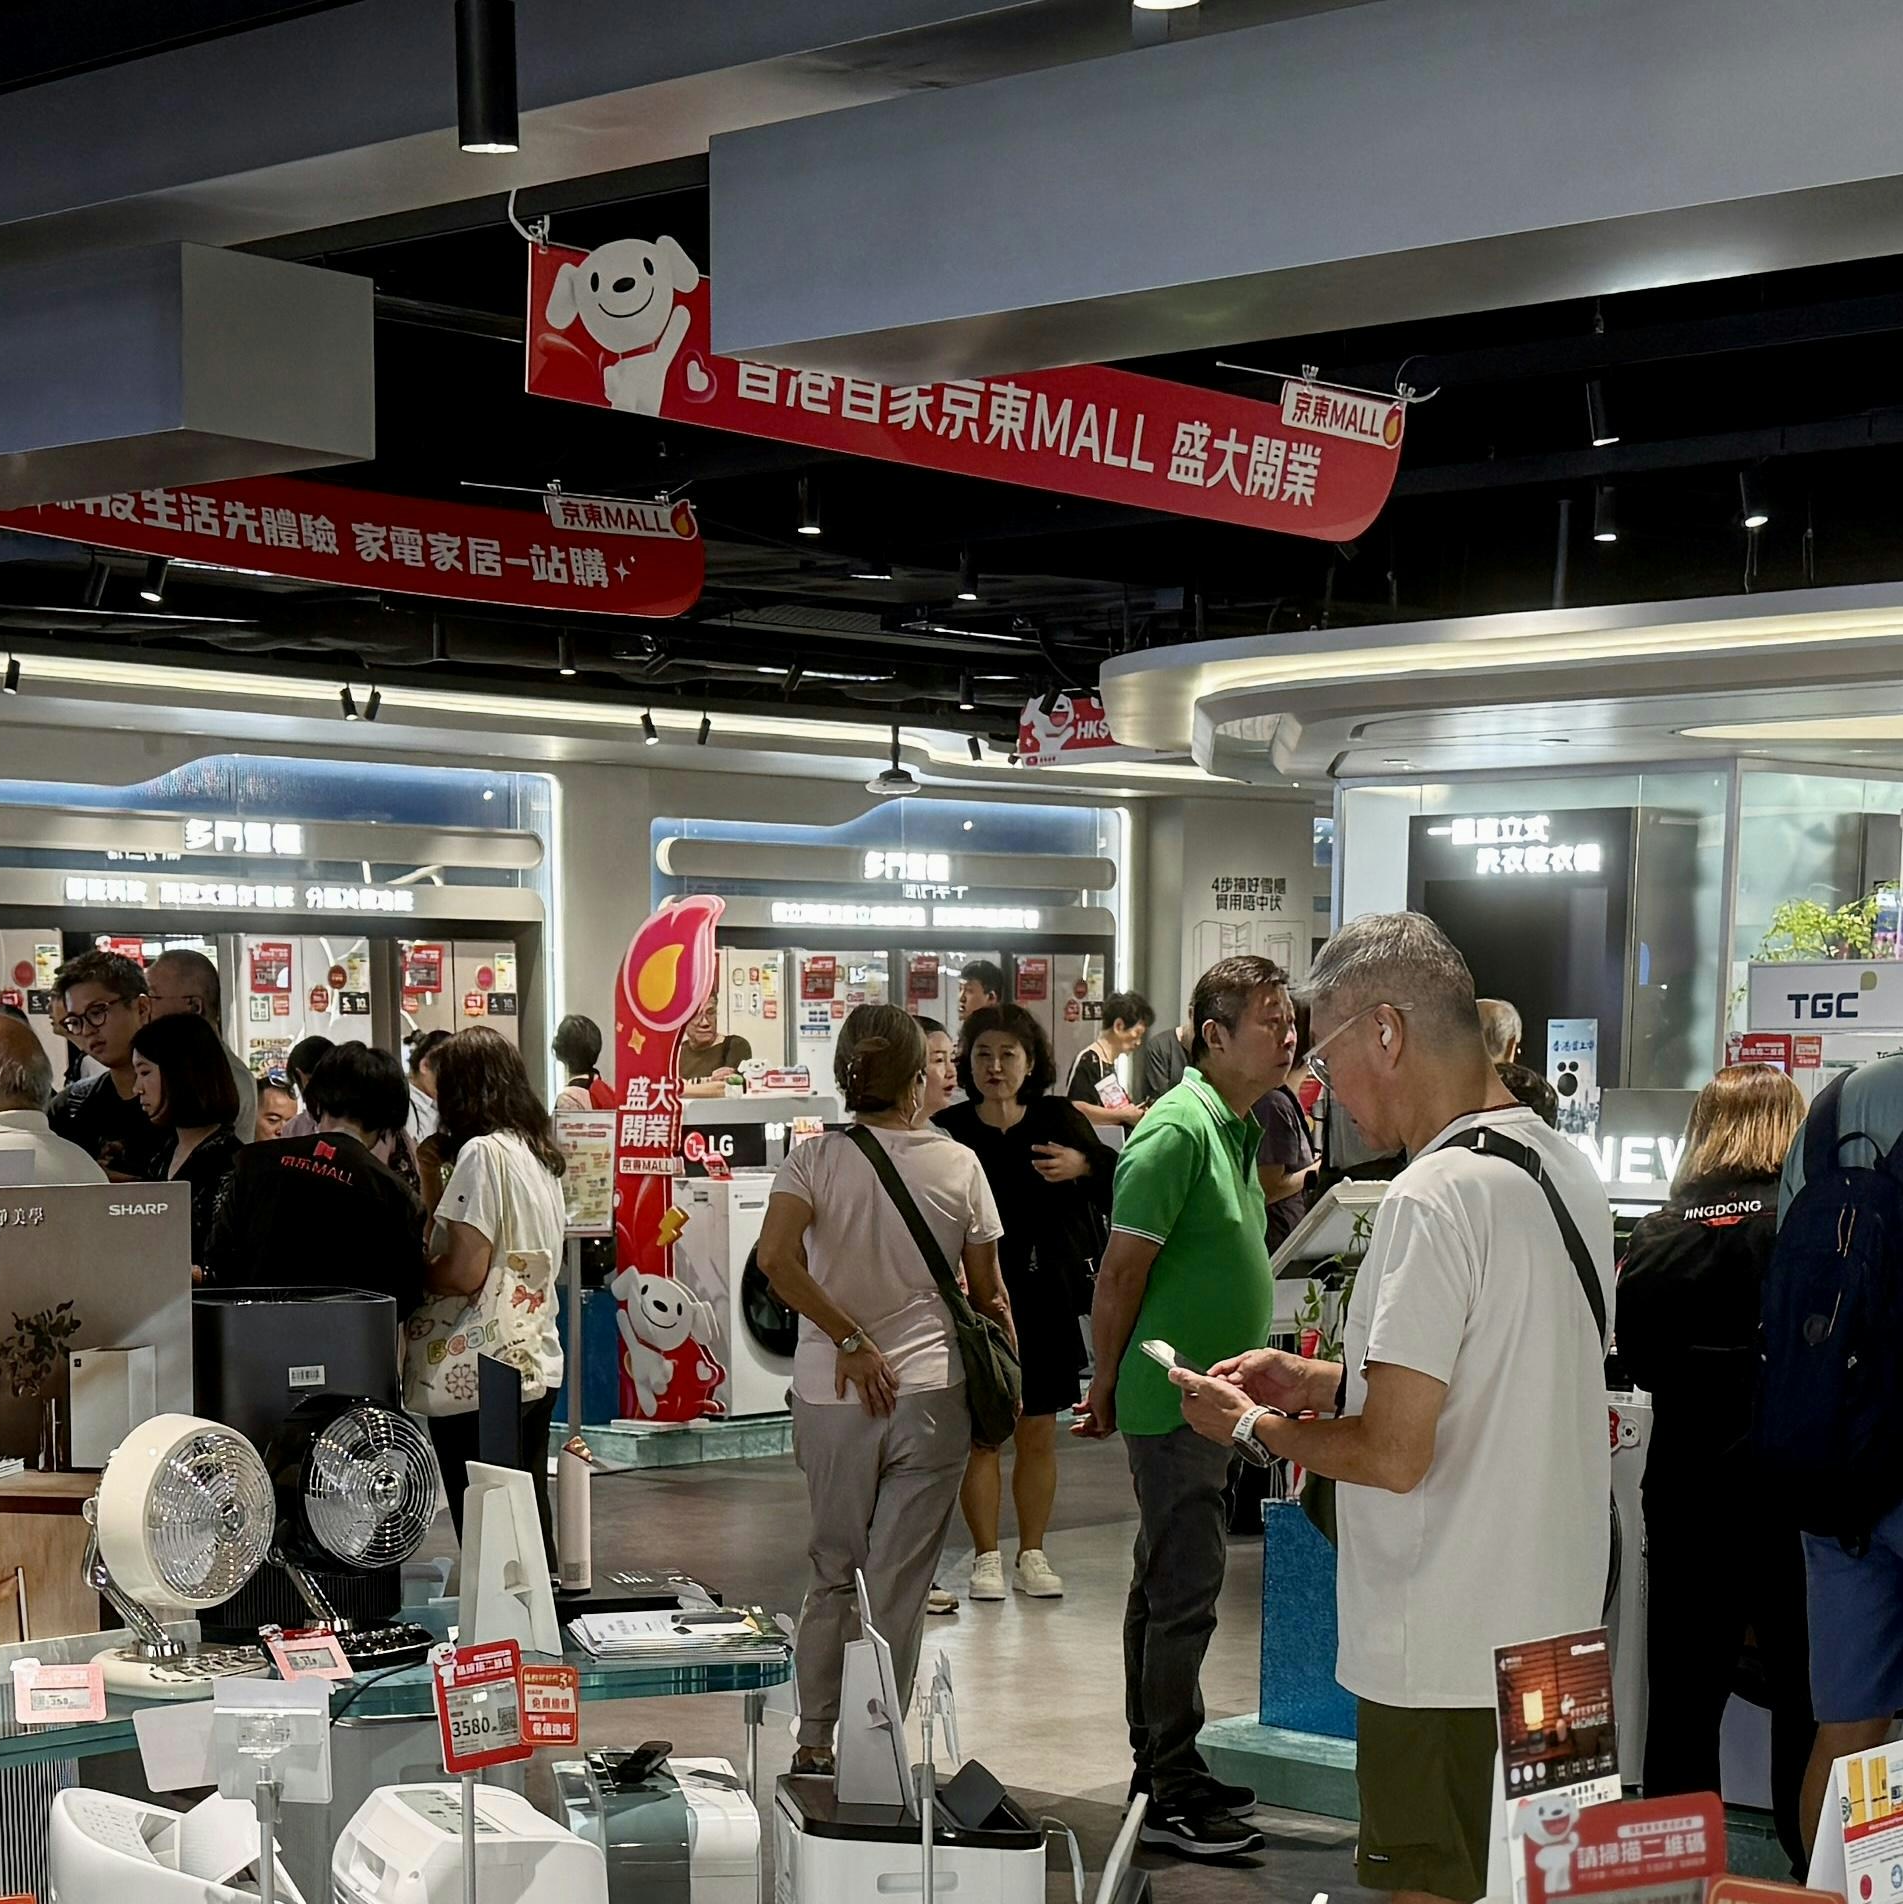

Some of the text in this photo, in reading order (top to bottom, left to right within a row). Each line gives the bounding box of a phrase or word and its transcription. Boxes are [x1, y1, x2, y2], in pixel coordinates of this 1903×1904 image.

[1289, 390, 1386, 438] 京東MALL
[1167, 420, 1322, 509] 盛大開業
[561, 502, 671, 534] 京東MALL
[351, 521, 609, 590] 家電家居一站購
[1786, 991, 1860, 1020] TGC
[618, 1075, 675, 1112] 盛大
[619, 1113, 670, 1149] 開業
[709, 1134, 735, 1157] LG
[107, 1202, 170, 1217] SHARP
[1683, 1199, 1763, 1221] JINGDONG
[451, 1716, 492, 1738] 3580
[1576, 1832, 1708, 1873] 請掃描二維碼
